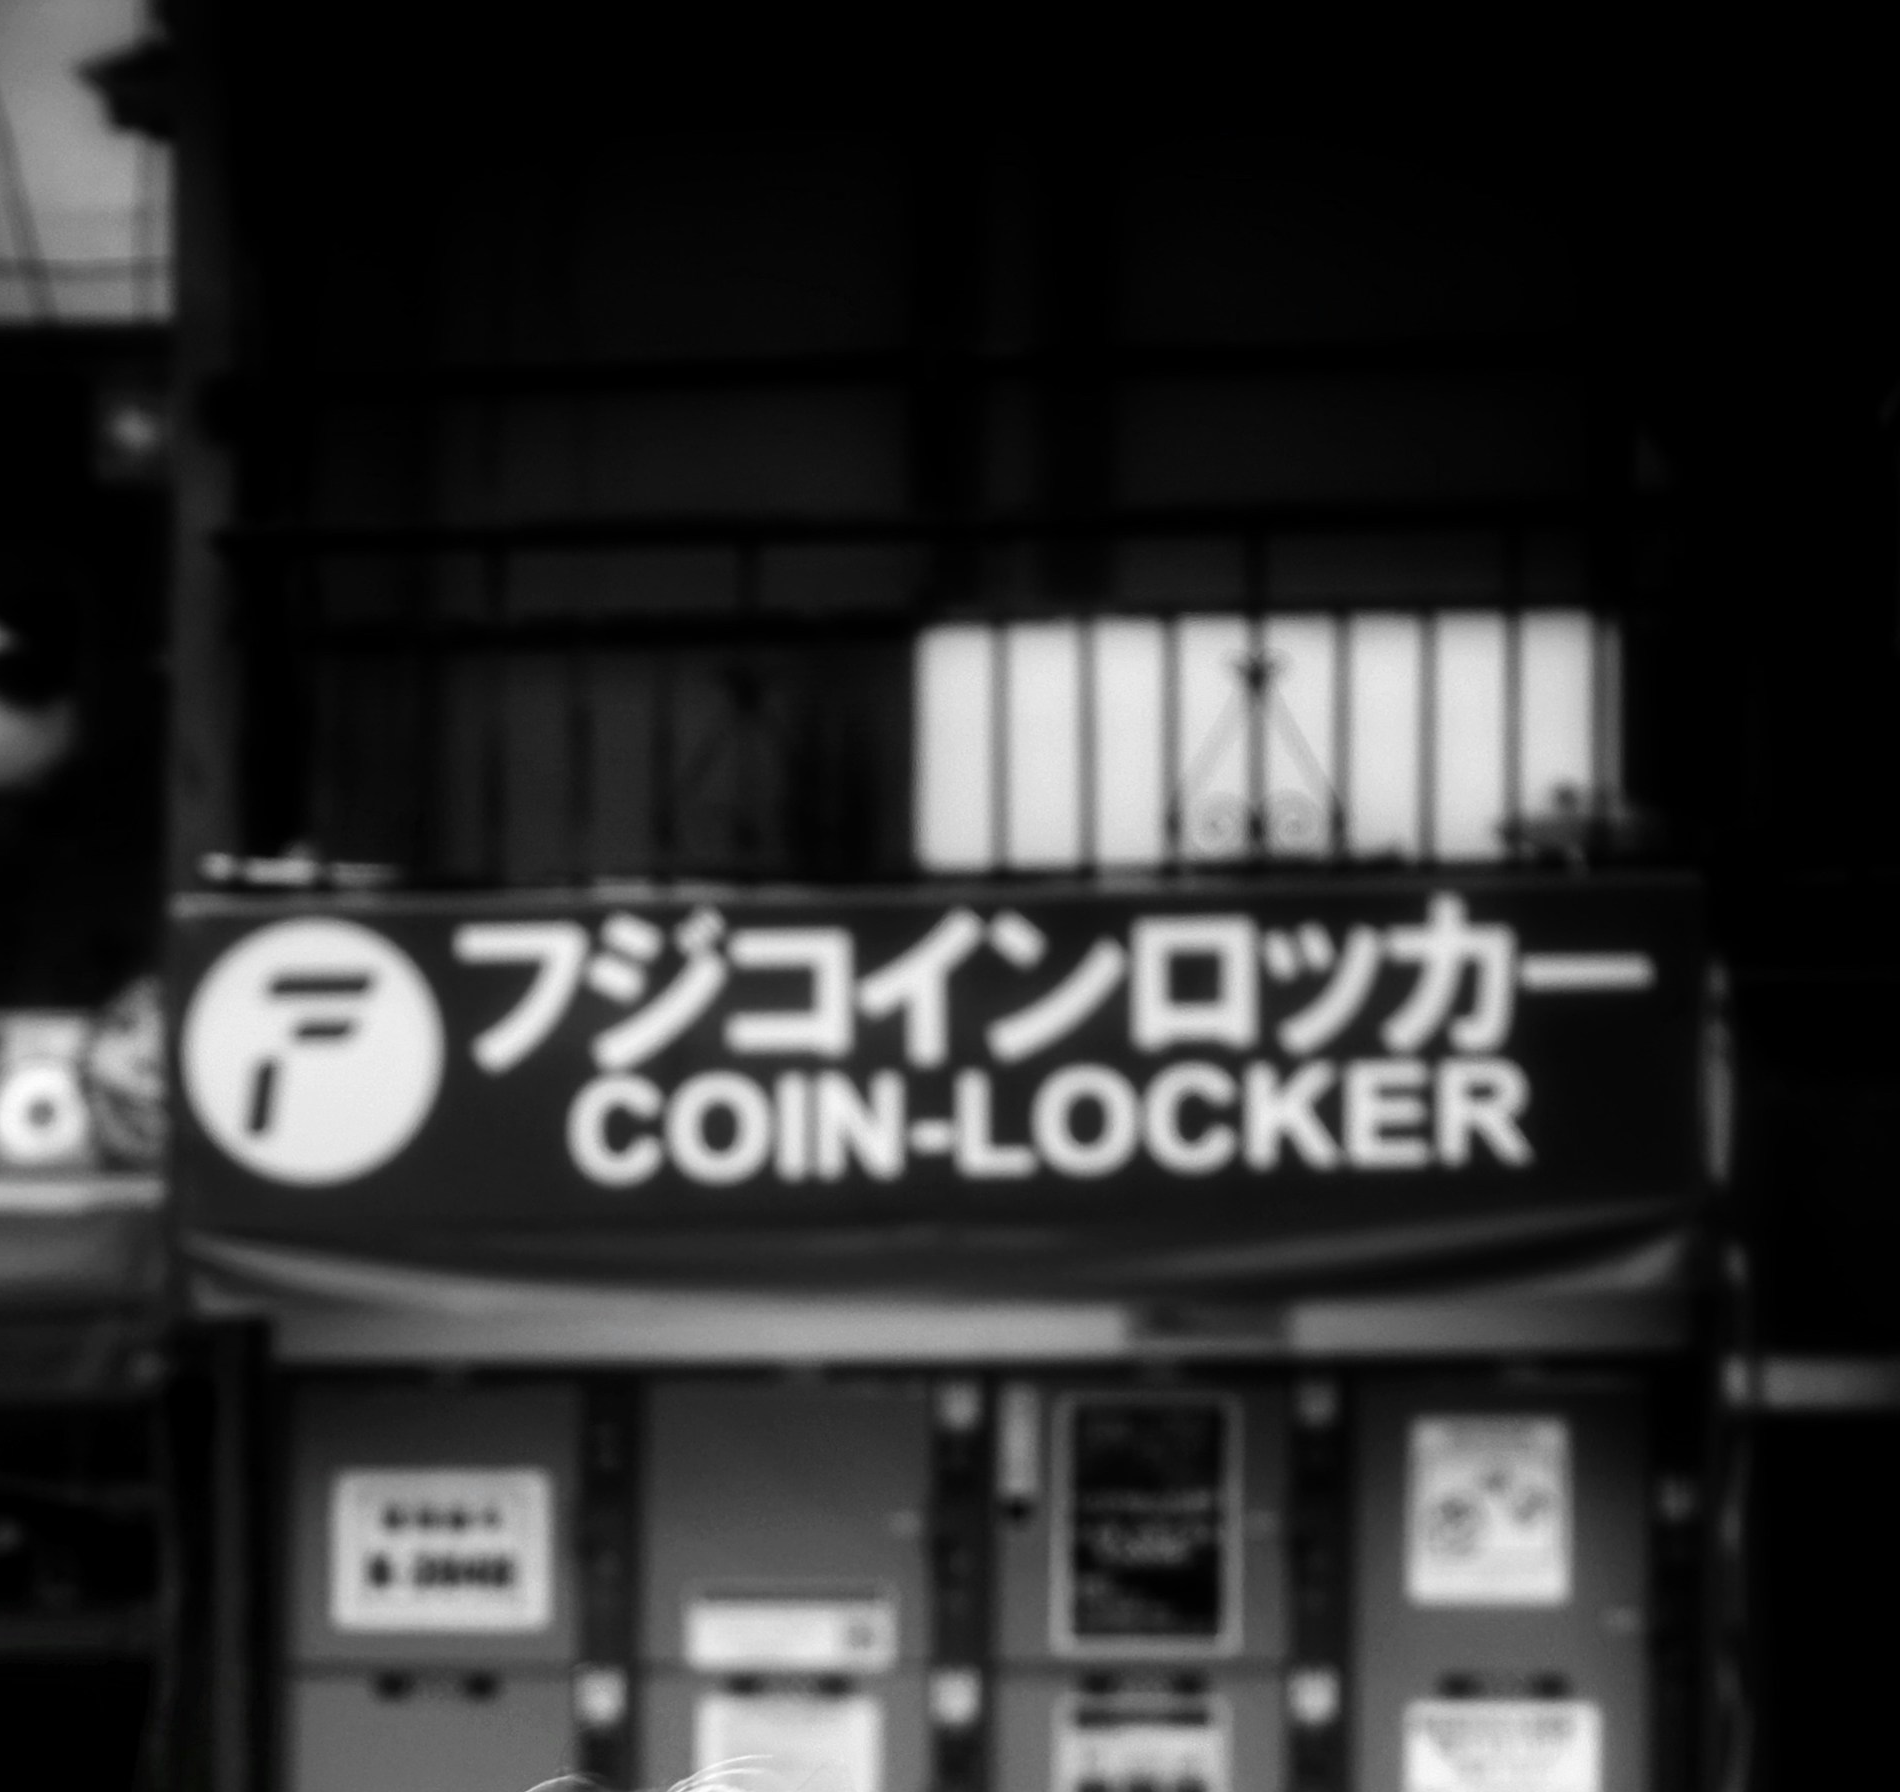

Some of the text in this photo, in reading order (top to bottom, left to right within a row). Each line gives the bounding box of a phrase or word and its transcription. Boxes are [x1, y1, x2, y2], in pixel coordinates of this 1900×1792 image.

[453, 895, 1656, 1073] フジコインロッカー
[567, 1060, 1534, 1188] COIN-LOCKER
